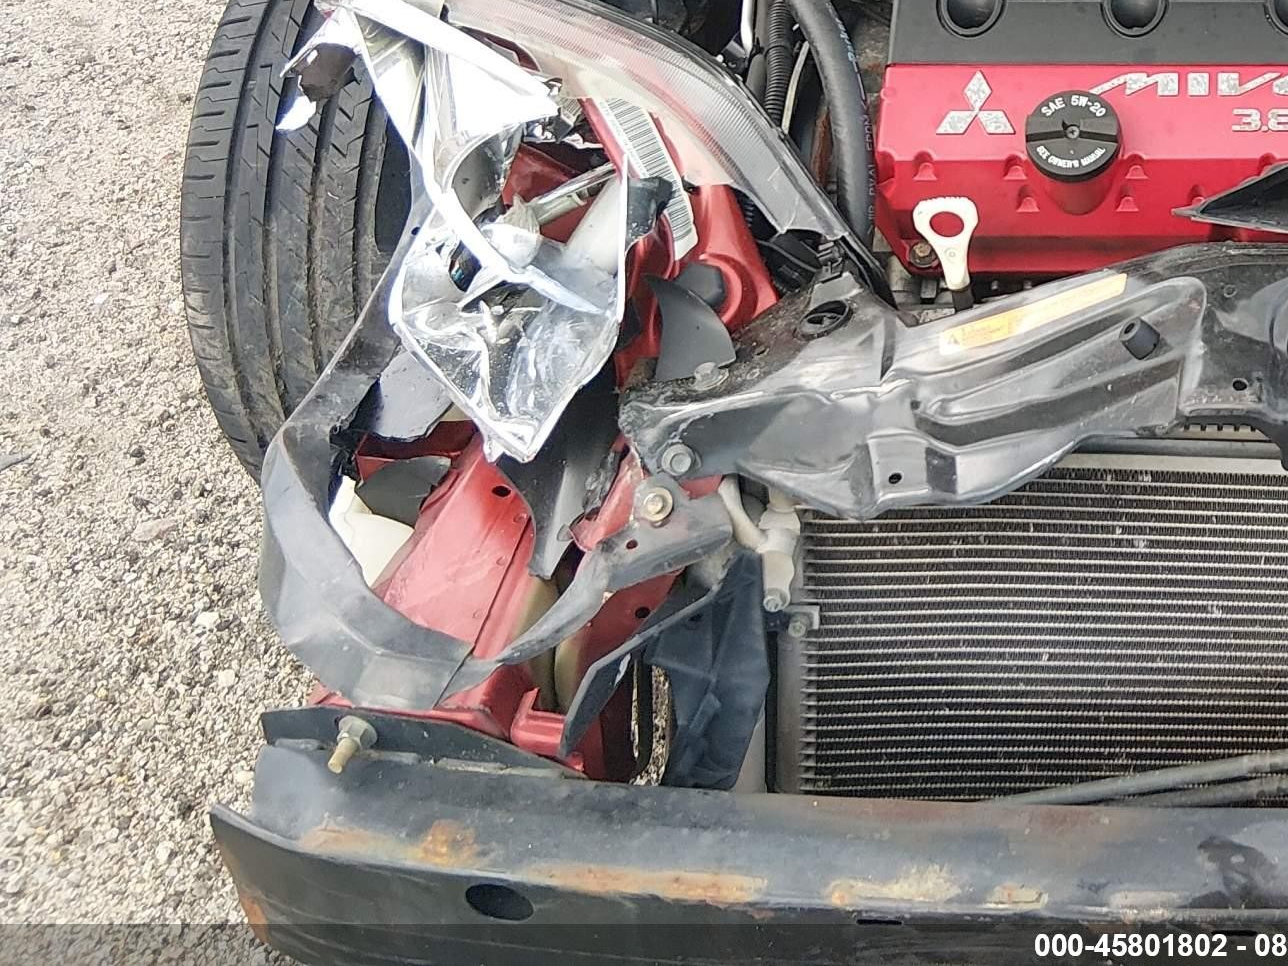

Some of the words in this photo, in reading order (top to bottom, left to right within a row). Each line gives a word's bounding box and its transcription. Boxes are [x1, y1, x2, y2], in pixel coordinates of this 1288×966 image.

[1041, 97, 1066, 117] SAE
[1070, 94, 1107, 117] 5W-20
[1036, 145, 1051, 160] SEE
[1080, 147, 1106, 167] MANUAL
